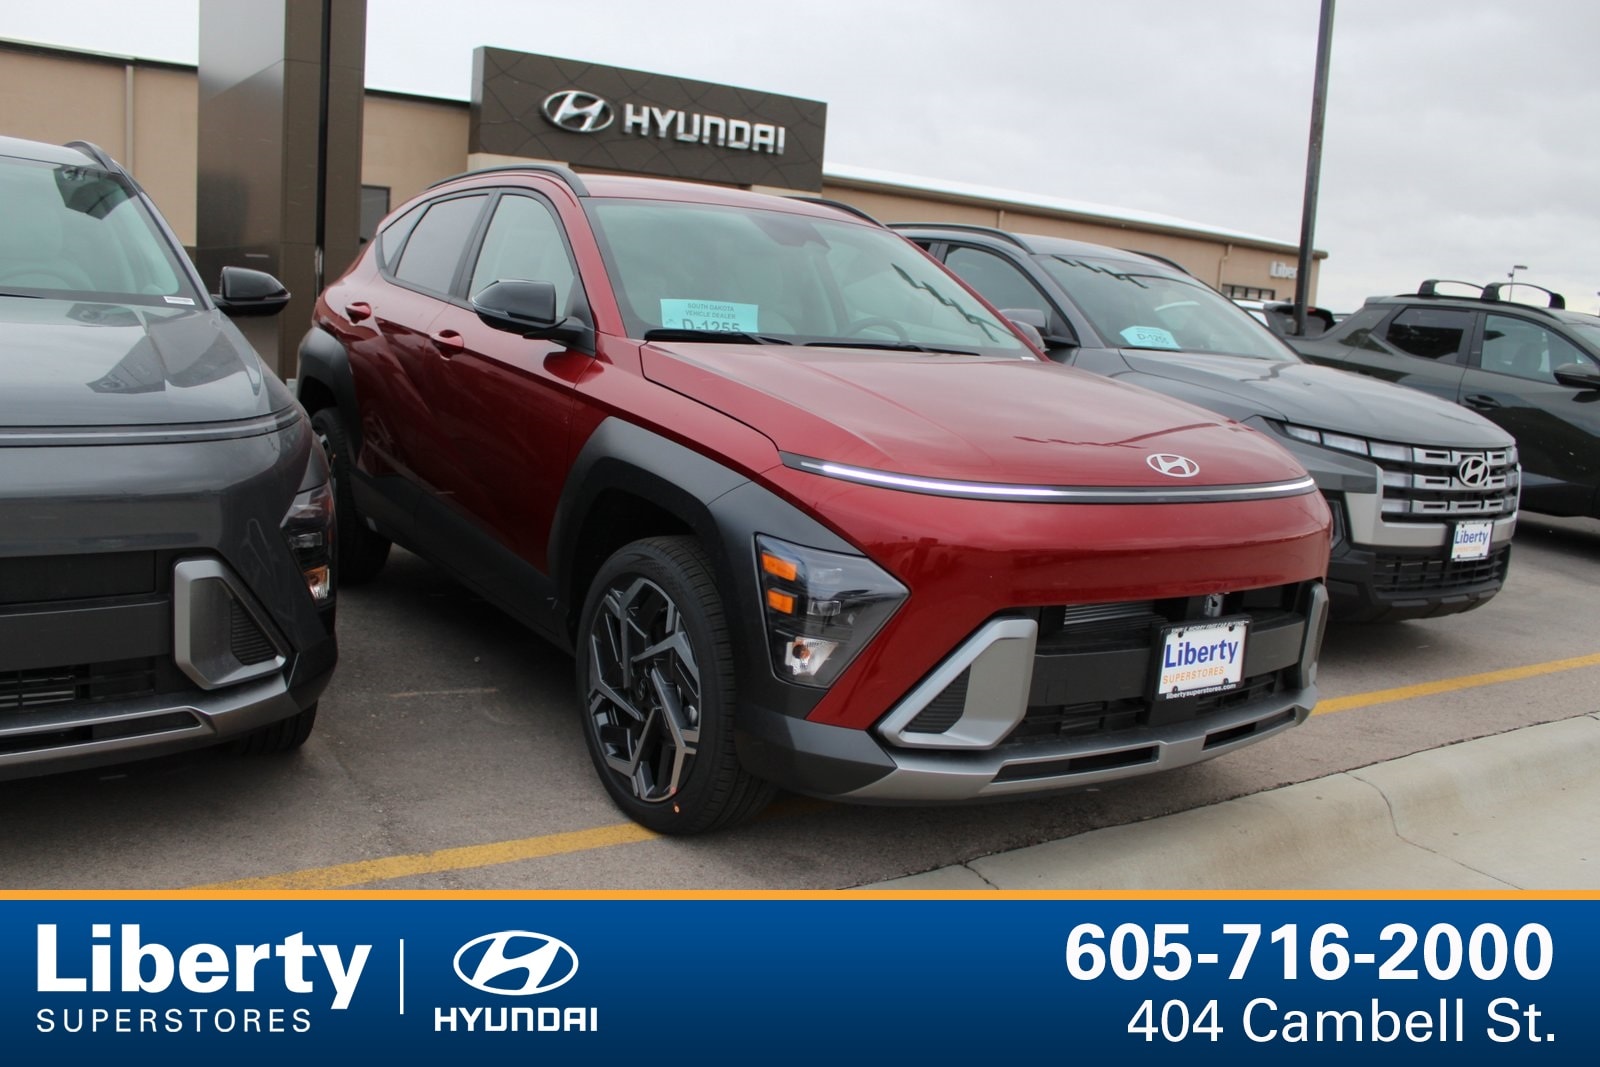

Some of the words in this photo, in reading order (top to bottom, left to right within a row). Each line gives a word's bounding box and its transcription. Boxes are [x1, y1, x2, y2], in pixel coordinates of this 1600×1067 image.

[623, 103, 786, 155] HYUNDAI
[1270, 261, 1298, 279] Liber
[685, 310, 711, 318] VEHICLE
[712, 312, 736, 320] DEALER
[709, 304, 734, 312] DAKOTA
[1454, 530, 1489, 545] Liberty
[1164, 639, 1239, 668] Liberty
[1163, 665, 1225, 685] SUPERSTORES
[1166, 683, 1237, 700] libertysuperstores.com
